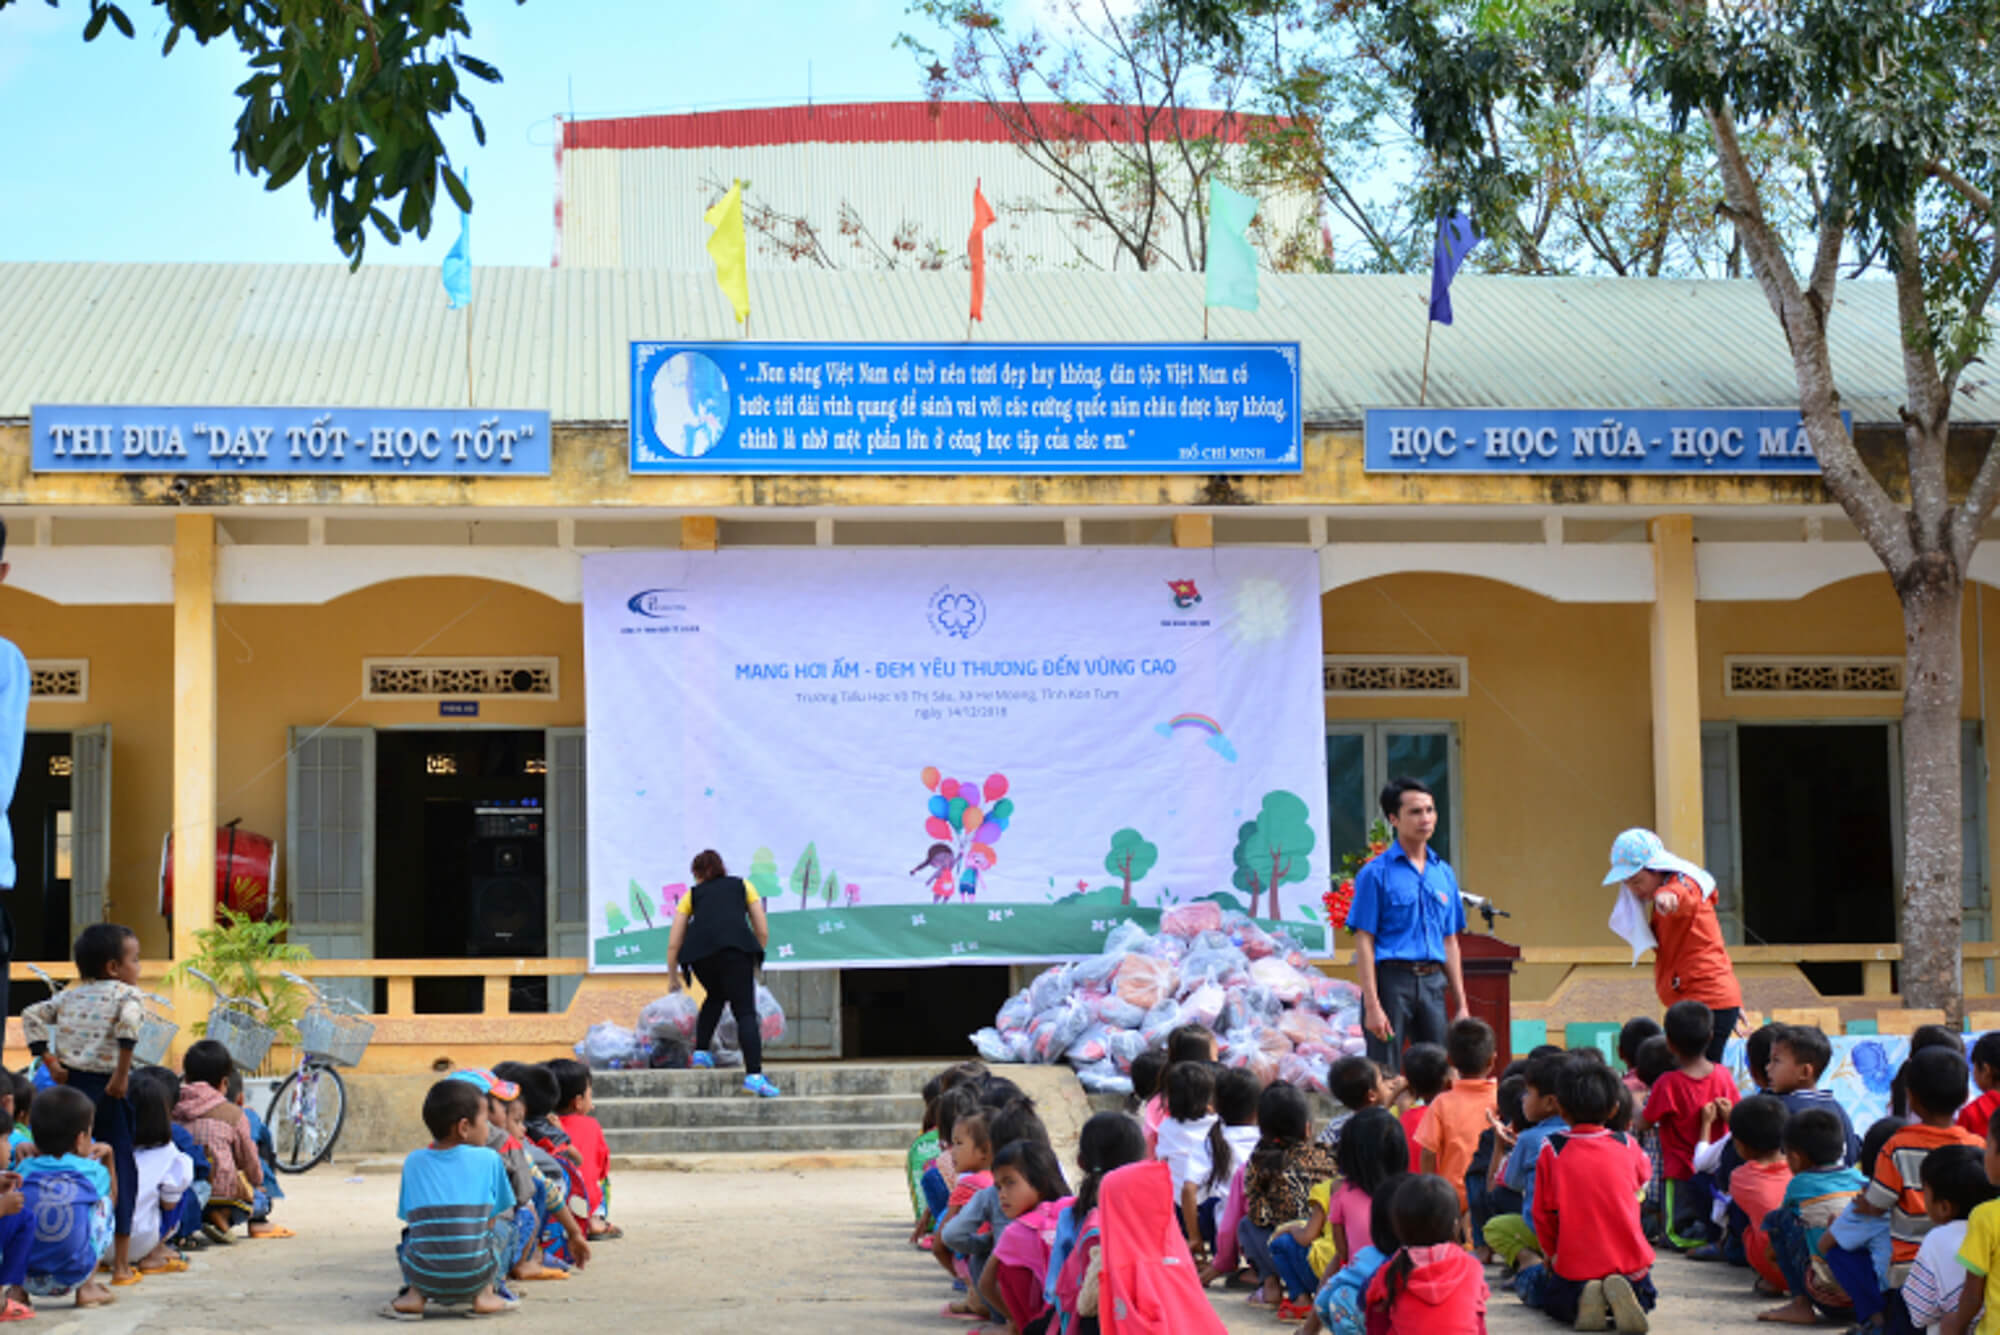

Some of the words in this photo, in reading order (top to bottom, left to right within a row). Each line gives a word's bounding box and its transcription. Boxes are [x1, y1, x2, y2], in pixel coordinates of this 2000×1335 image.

[789, 361, 822, 390] sông
[825, 361, 854, 389] Việt
[859, 361, 889, 385] Nam
[893, 361, 910, 385] có
[940, 362, 966, 385] nên
[1031, 361, 1055, 390] hay
[1139, 362, 1161, 389] tộc
[1165, 362, 1194, 389] Việt
[1198, 363, 1229, 385] Nam
[1232, 361, 1248, 385] có
[823, 394, 853, 416] vinh
[857, 398, 898, 424] quang
[921, 395, 952, 416] sánh
[957, 395, 976, 416] vai
[1005, 395, 1028, 416] các
[1215, 395, 1239, 423] hay
[50, 423, 112, 457] THI
[122, 424, 188, 457] ĐUA
[286, 412, 348, 459] TỐT
[370, 426, 440, 467] HỌC
[949, 428, 981, 456] công
[987, 427, 1012, 455] học
[1075, 427, 1099, 450] các
[1230, 447, 1266, 460] MINH
[1389, 426, 1457, 464] HỌC
[1484, 427, 1558, 464] HỌC
[1572, 417, 1647, 457] NỮA
[1671, 427, 1744, 465] HỌC
[735, 662, 789, 680] MANG
[795, 661, 827, 680] HƠI
[832, 656, 860, 679] ẤM
[876, 660, 915, 679] ĐEM
[920, 656, 955, 678] YÊU
[961, 659, 1038, 677] THƯƠNG
[1042, 653, 1080, 677] ĐẾN
[1084, 655, 1135, 677] VÙNG
[1141, 658, 1176, 676] CAO
